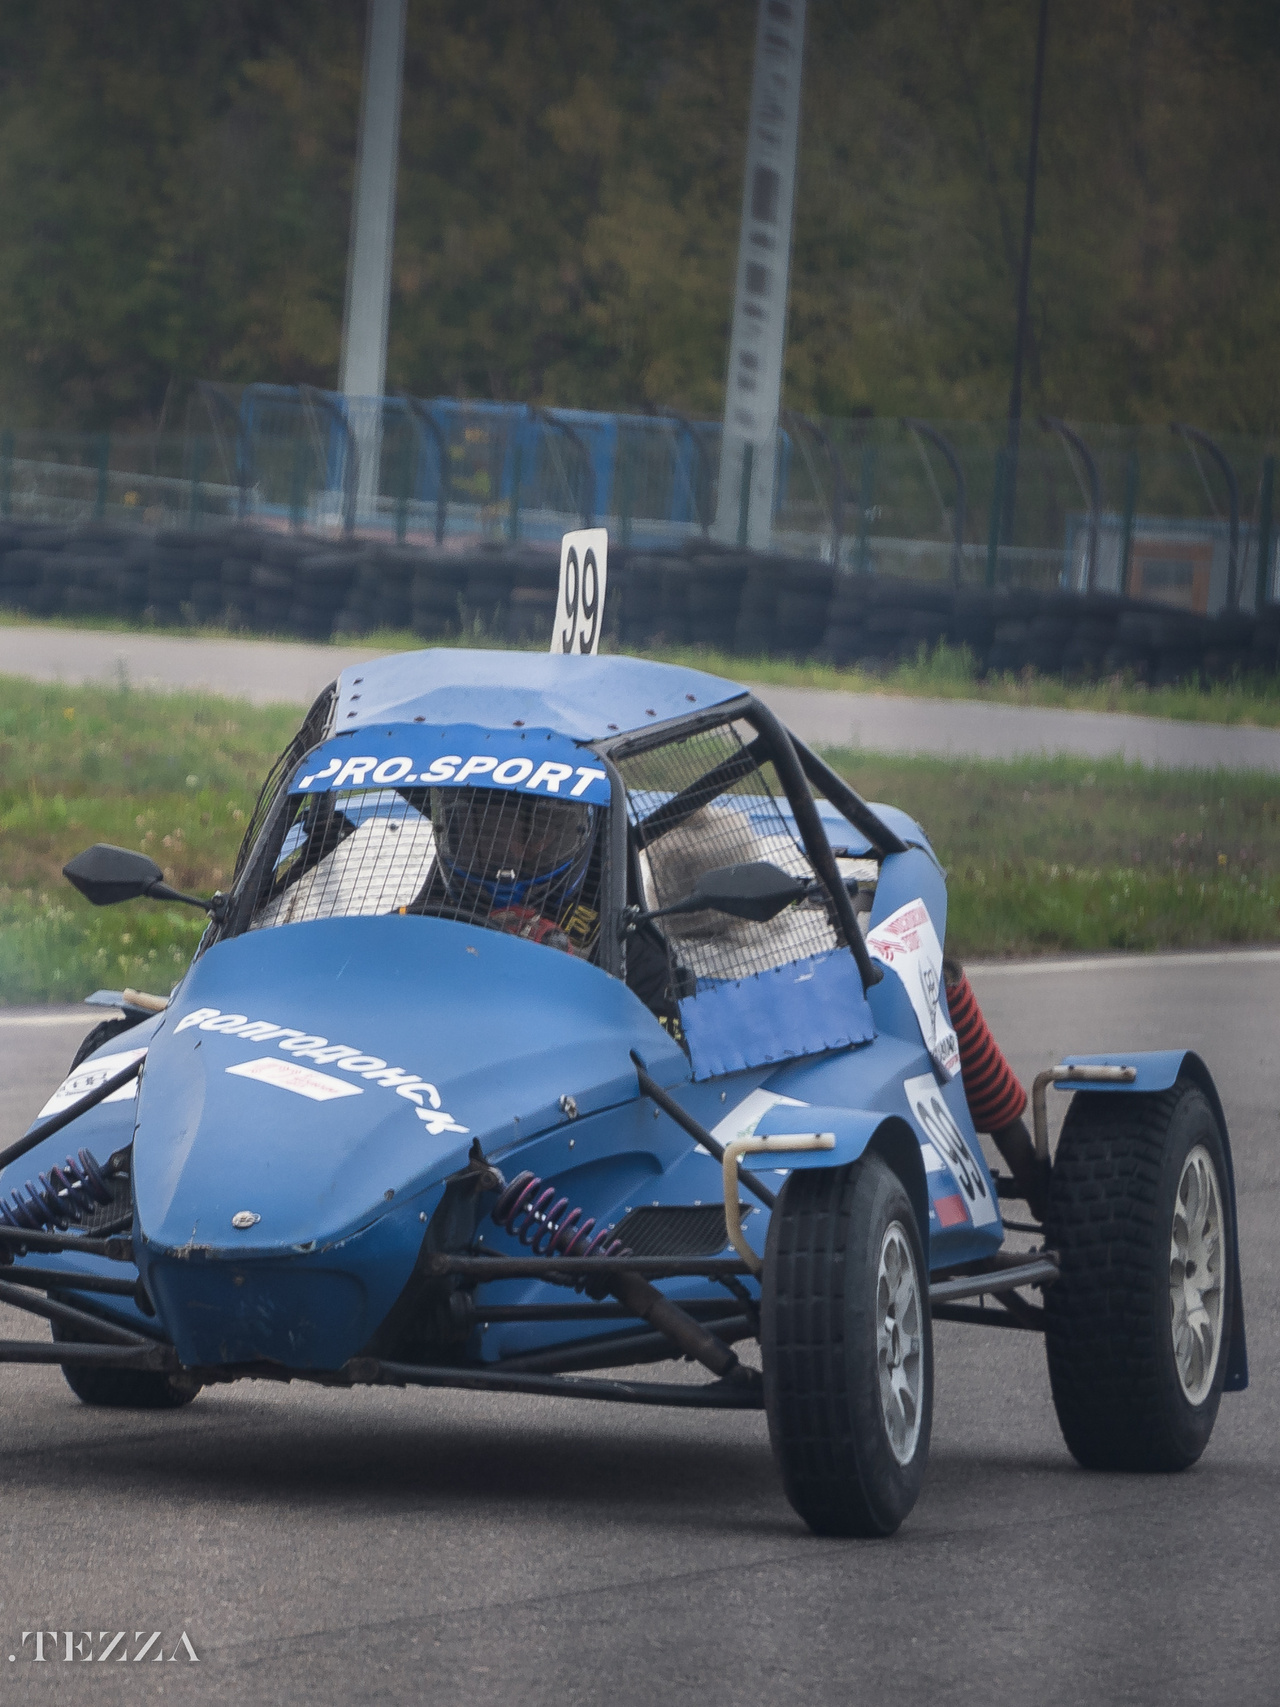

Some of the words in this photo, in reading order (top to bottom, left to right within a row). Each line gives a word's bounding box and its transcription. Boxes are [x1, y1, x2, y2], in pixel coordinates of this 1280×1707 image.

[562, 545, 599, 654] 99
[298, 755, 606, 797] PRO.SPORT
[172, 1007, 470, 1136] ВОЛГОДОНСК
[916, 1096, 986, 1201] 99
